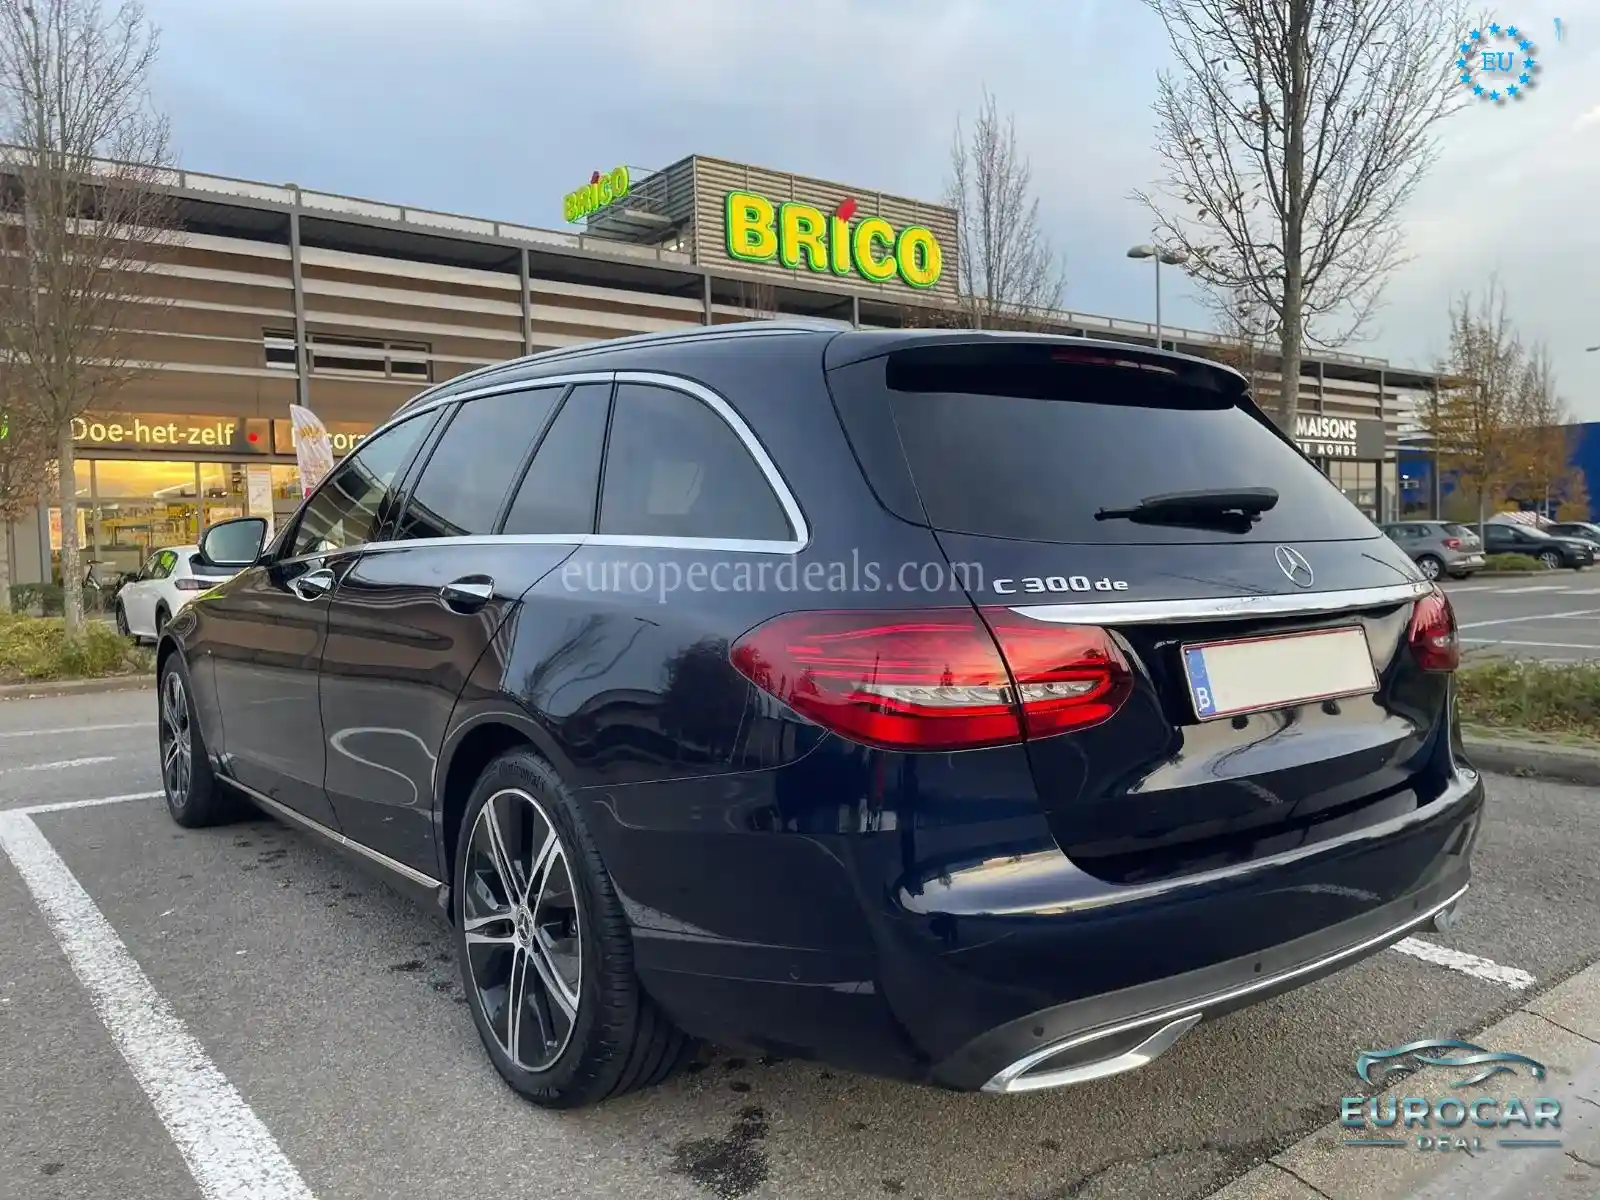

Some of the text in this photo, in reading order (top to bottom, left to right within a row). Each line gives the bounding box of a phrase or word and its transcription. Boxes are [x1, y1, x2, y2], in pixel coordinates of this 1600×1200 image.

[71, 417, 235, 447] Doe-het-zelf
[1295, 416, 1357, 439] MAISONS
[1318, 443, 1357, 456] MONDE
[993, 576, 1129, 595] C 300 de
[1196, 687, 1210, 709] B
